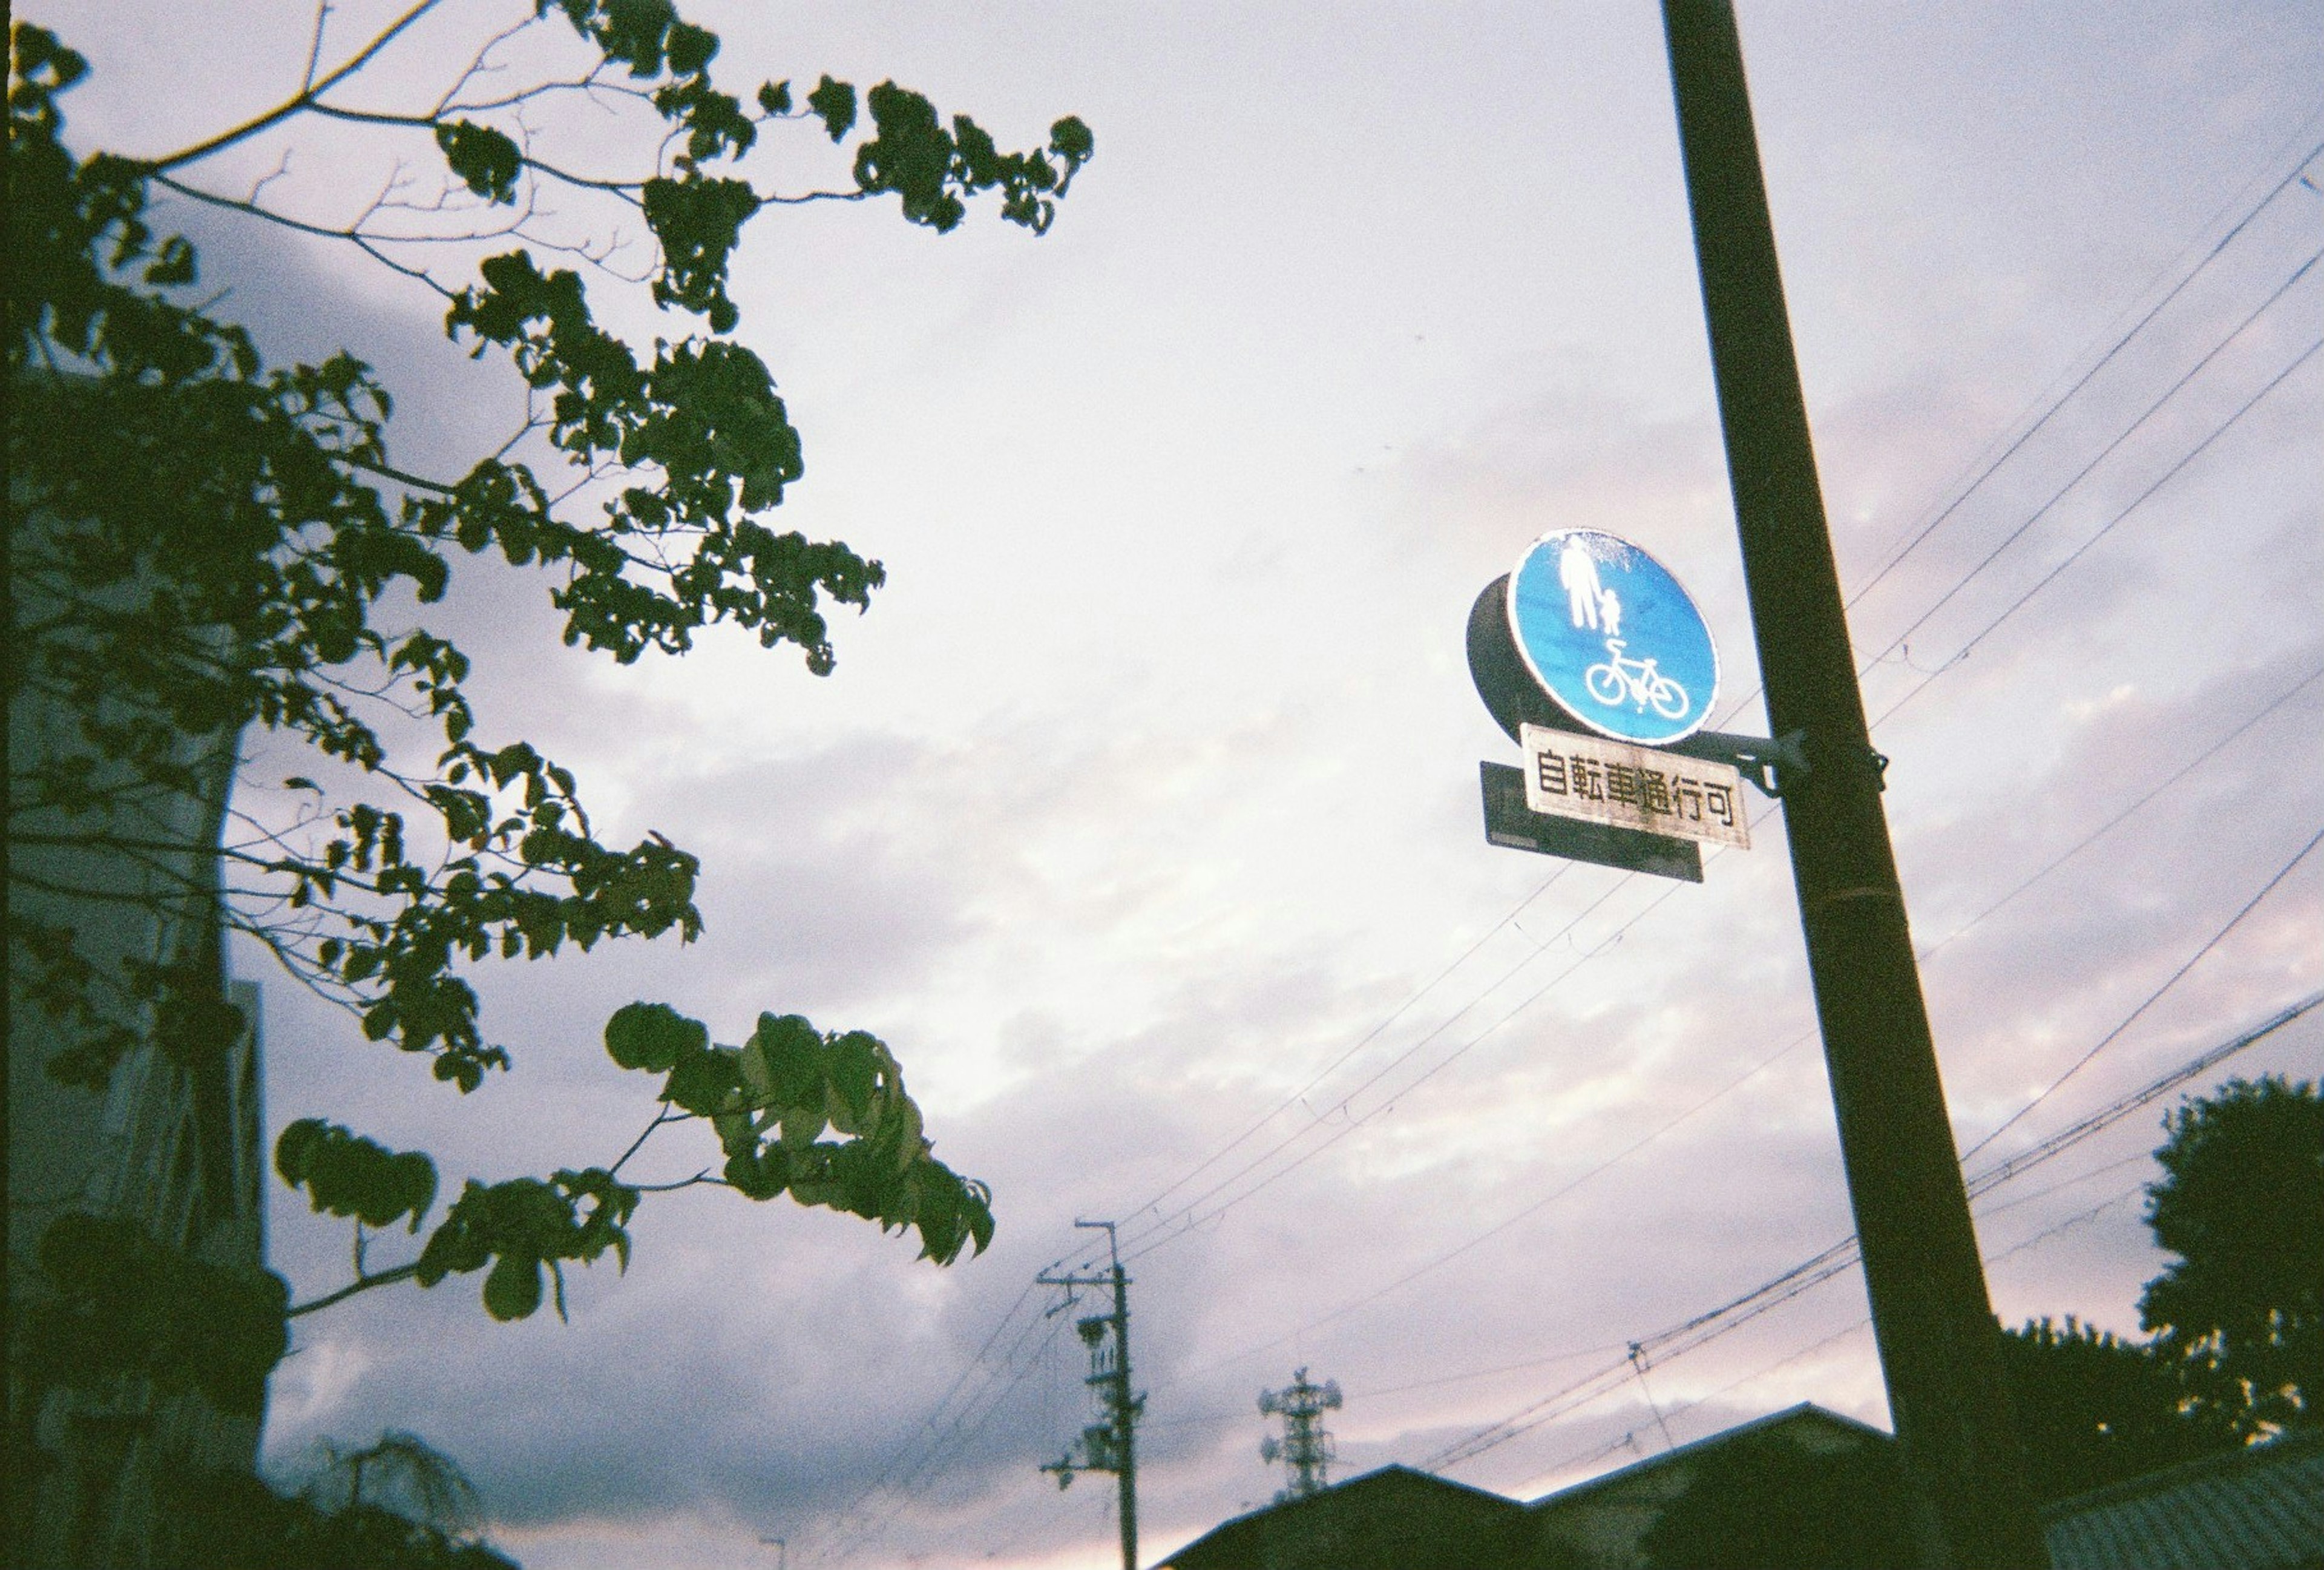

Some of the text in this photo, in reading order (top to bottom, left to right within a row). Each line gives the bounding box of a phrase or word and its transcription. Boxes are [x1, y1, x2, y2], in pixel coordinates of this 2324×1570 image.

[1538, 749, 1734, 827] 自転車通行可
